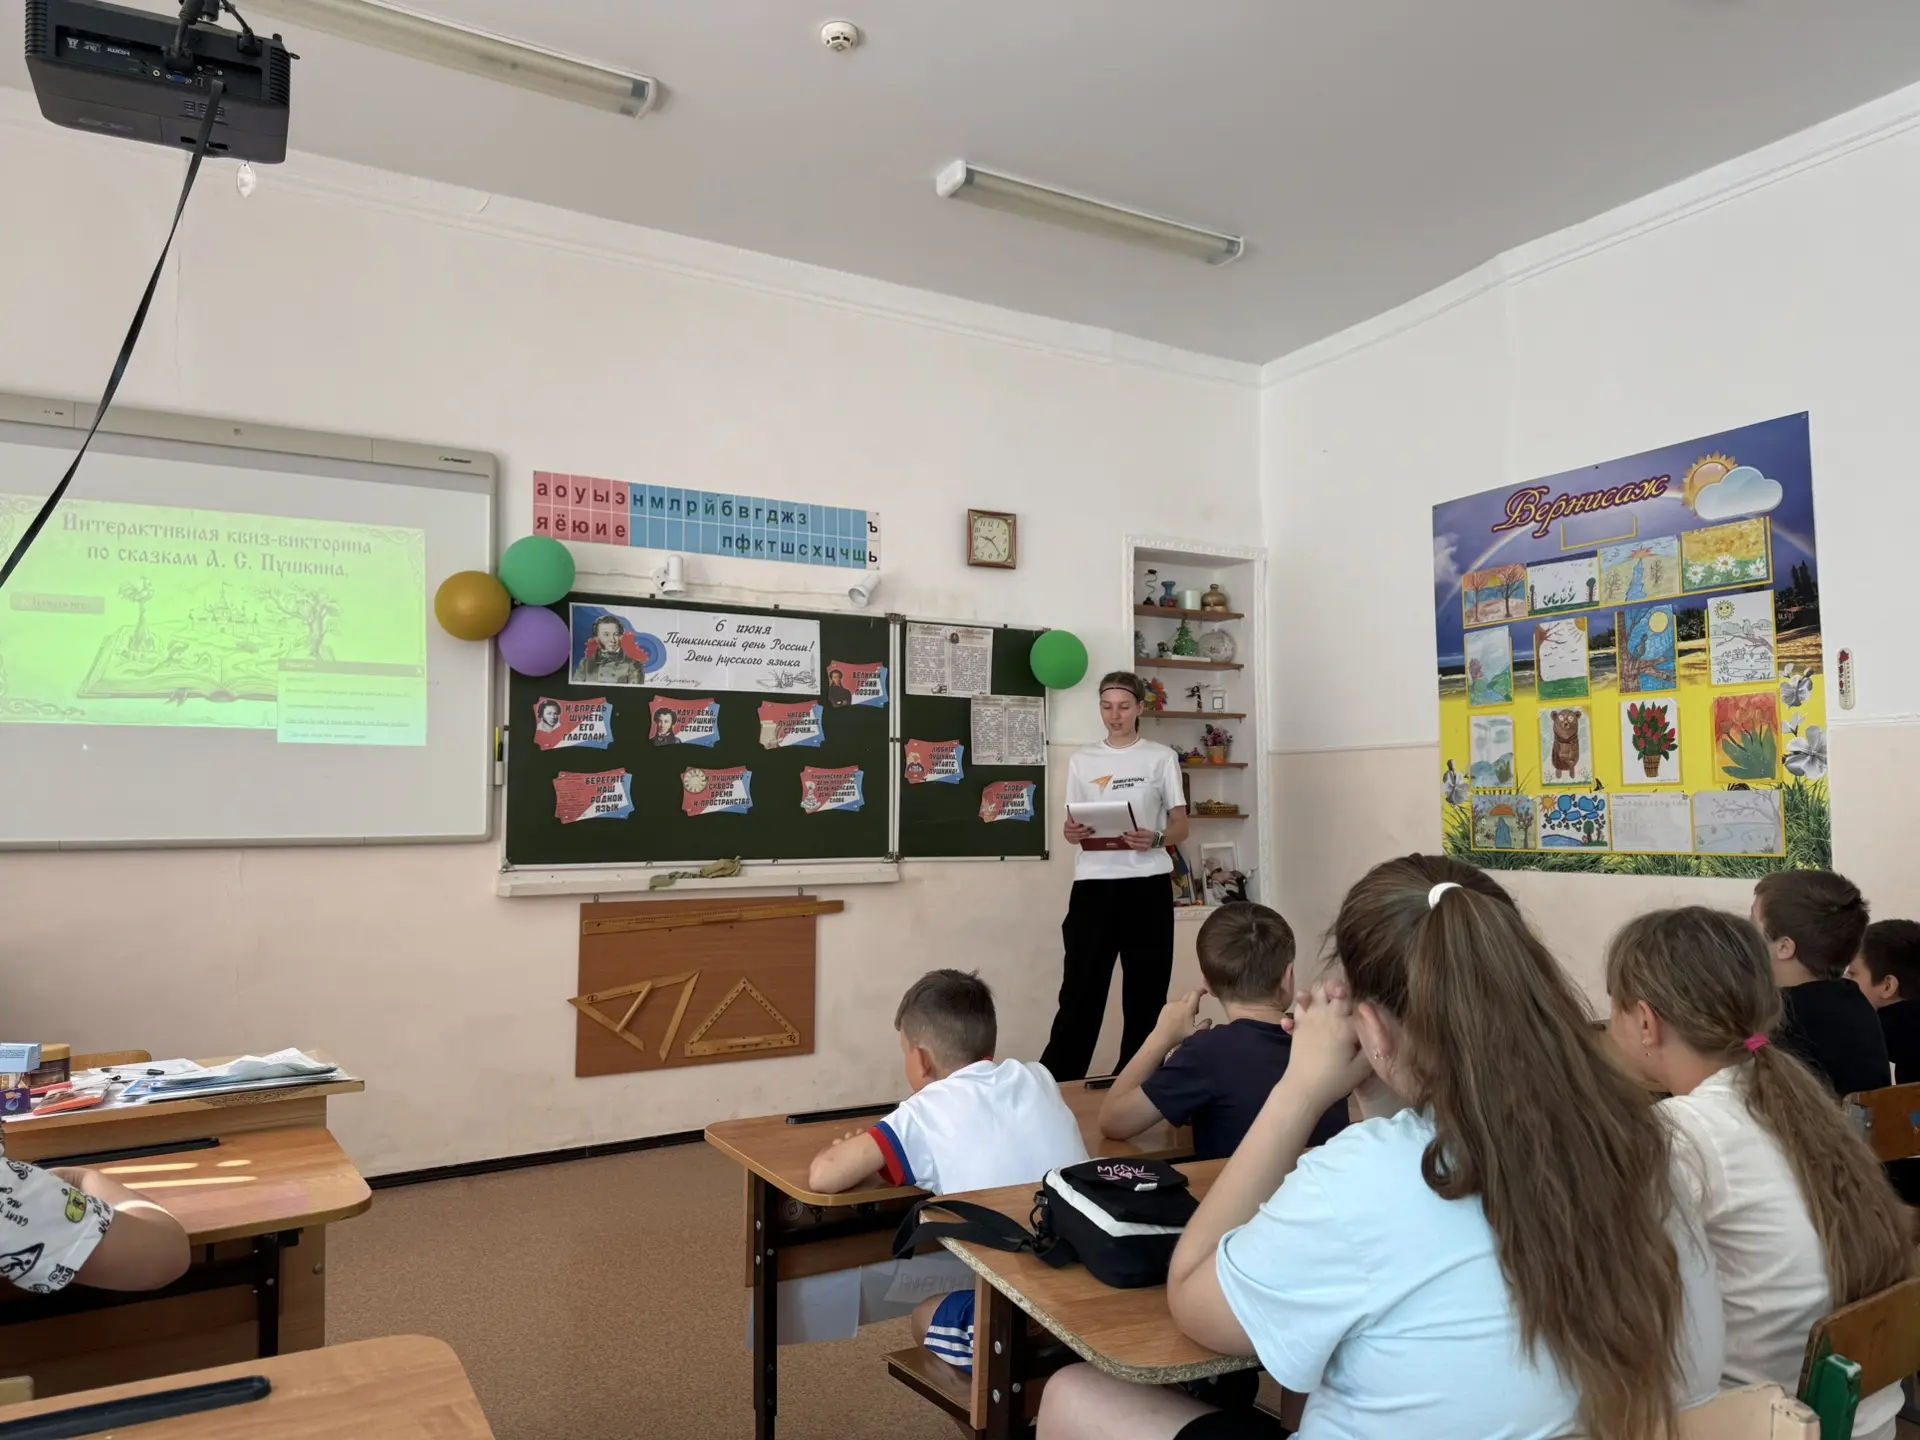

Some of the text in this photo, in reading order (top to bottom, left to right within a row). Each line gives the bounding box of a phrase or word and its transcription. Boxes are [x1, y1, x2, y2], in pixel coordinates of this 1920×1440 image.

[1491, 474, 1671, 539] Вернисаж
[62, 512, 372, 557] Интерактивная квиз-викторина
[88, 546, 109, 560] по
[118, 548, 198, 566] сказкам
[206, 549, 225, 567] А.
[234, 551, 252, 569] С.
[715, 619, 772, 635] 6 июня
[663, 631, 815, 652] Пушкинский день России!
[684, 649, 801, 668] День русского языка
[574, 704, 607, 712] ВПРЕДЬ
[569, 714, 604, 722] ШУМЕТЬ
[563, 733, 605, 742] ГЛАГОЛАМ
[585, 776, 624, 784] БЕРЕГИТЕ
[597, 785, 615, 794] НАШ
[701, 798, 750, 806] ПРОСТРАНСТВО
[595, 804, 619, 813] ЯЗЫК
[1097, 1164, 1144, 1177] MEOW
